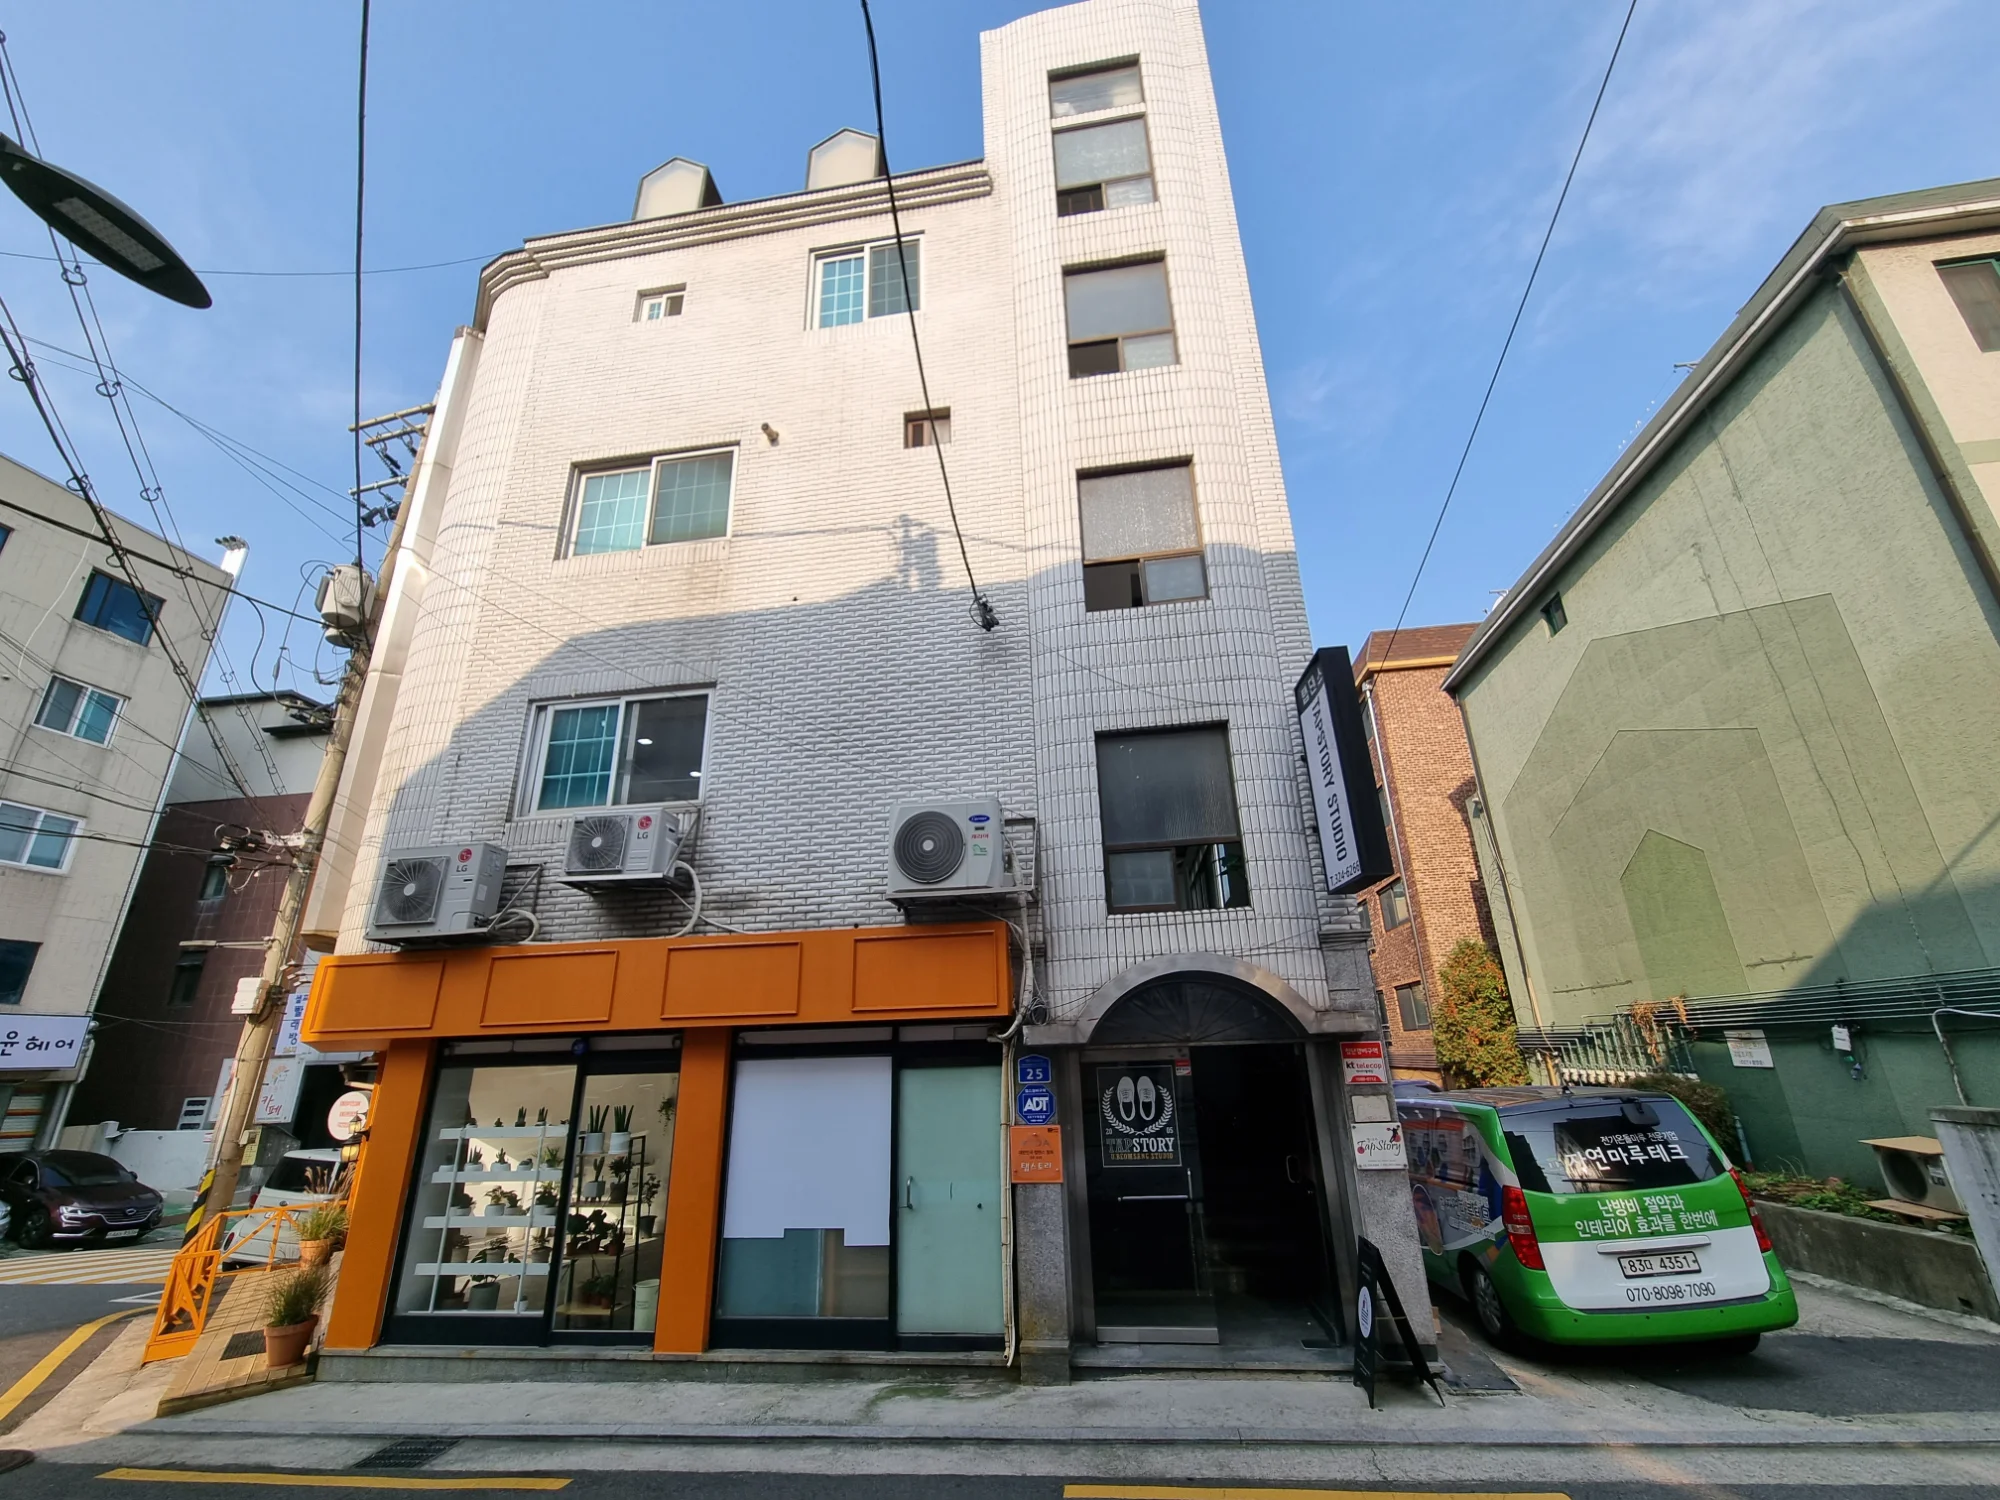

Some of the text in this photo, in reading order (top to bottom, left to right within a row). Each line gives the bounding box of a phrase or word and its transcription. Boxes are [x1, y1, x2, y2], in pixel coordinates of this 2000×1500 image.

[1312, 696, 1347, 862] TAPSTORY STUDIO
[636, 831, 649, 840] LG
[456, 864, 468, 873] LG
[1345, 1061, 1383, 1070] kt telecop
[1026, 1068, 1043, 1080] 25
[1023, 1096, 1049, 1111] ADT
[1105, 1126, 1174, 1135] 20 05
[1600, 1131, 1679, 1146] 전기온돌마루 전문기업
[1150, 1152, 1174, 1160] STUDIO
[1357, 1140, 1401, 1157] TapStory
[1565, 1144, 1690, 1173] 자연마루테크
[1020, 1162, 1052, 1172] 탭스토리
[1597, 1193, 1685, 1217] 난방비 절약과
[1575, 1209, 1719, 1237] 인테리어 효과를 한번에
[1660, 1255, 1691, 1271] 4351
